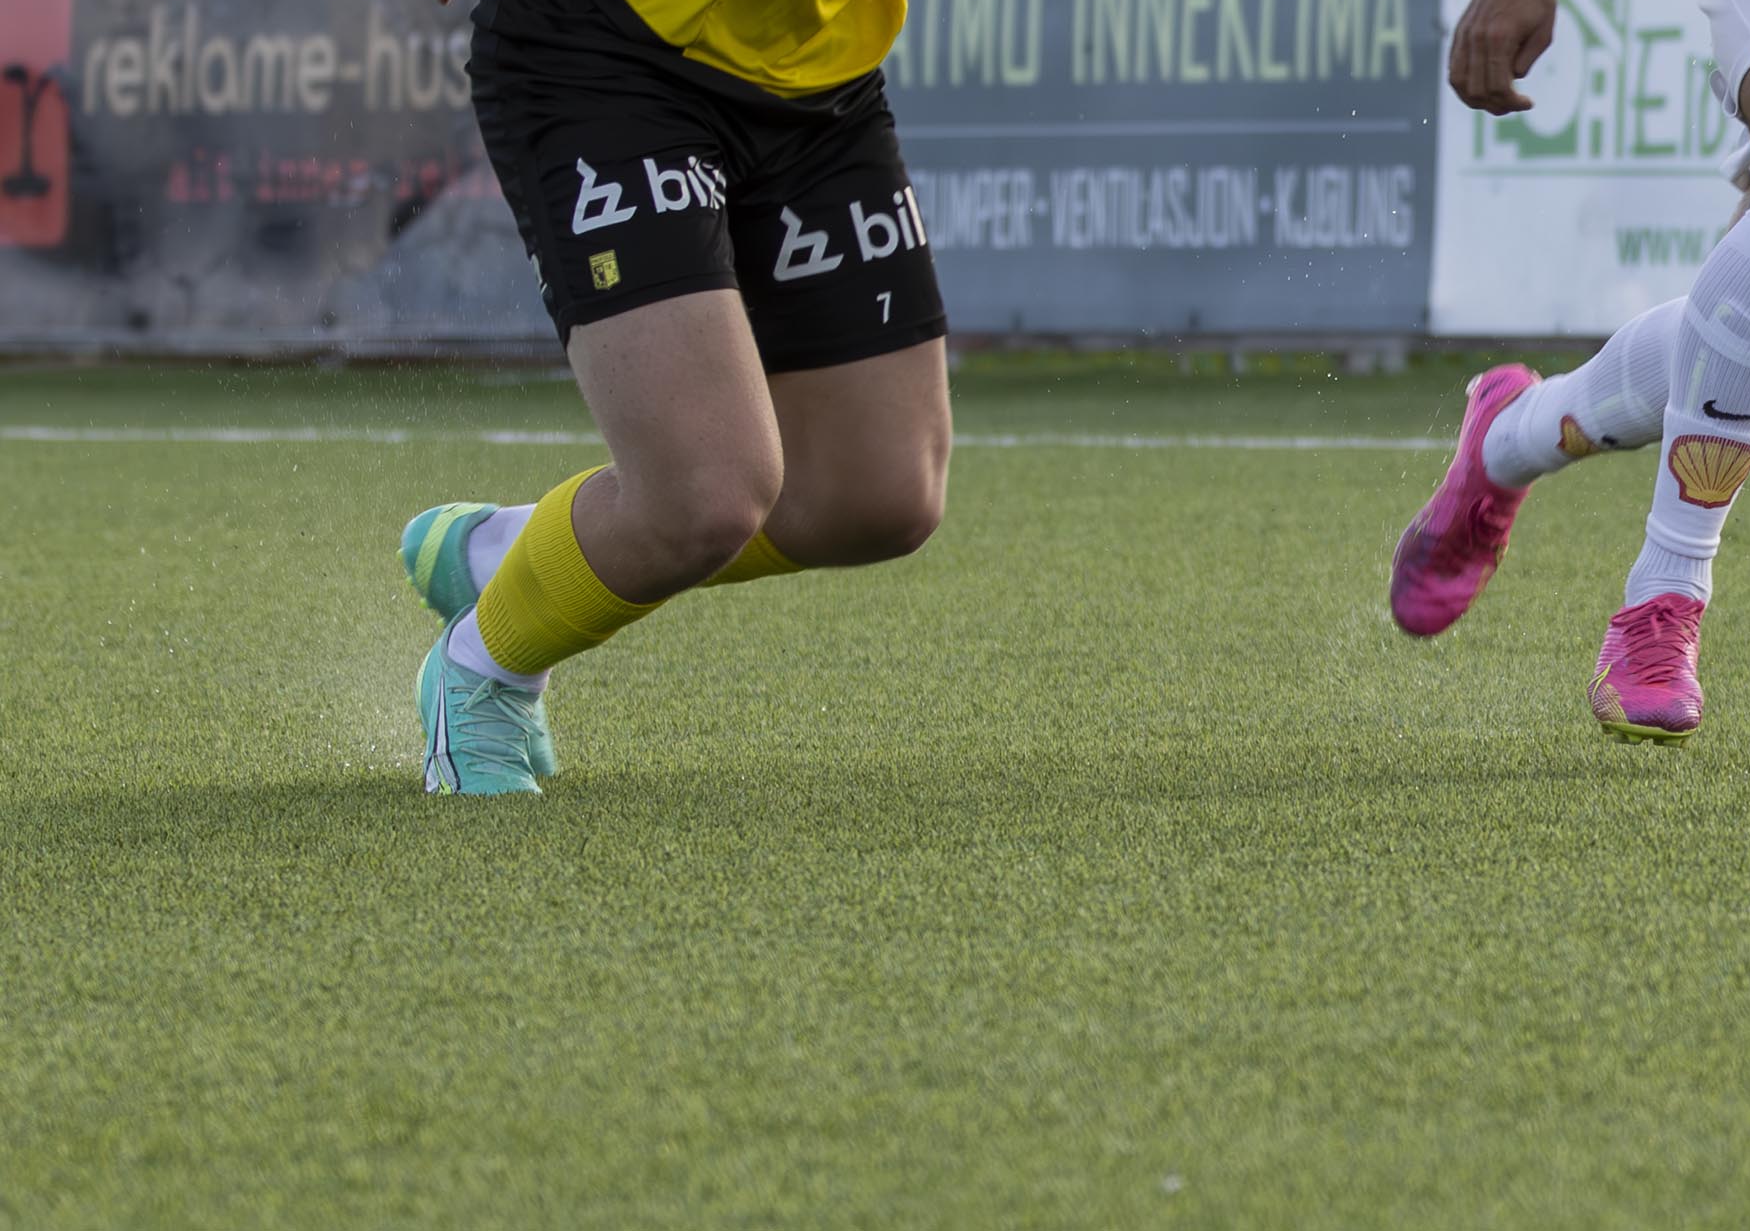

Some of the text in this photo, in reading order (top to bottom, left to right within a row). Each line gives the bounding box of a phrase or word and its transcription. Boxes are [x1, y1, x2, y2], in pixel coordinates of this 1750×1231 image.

[82, 2, 471, 116] reklame-hus
[849, 185, 928, 263] bil
[1050, 165, 1259, 250] VENTILASJON
[876, 290, 893, 324] 7
